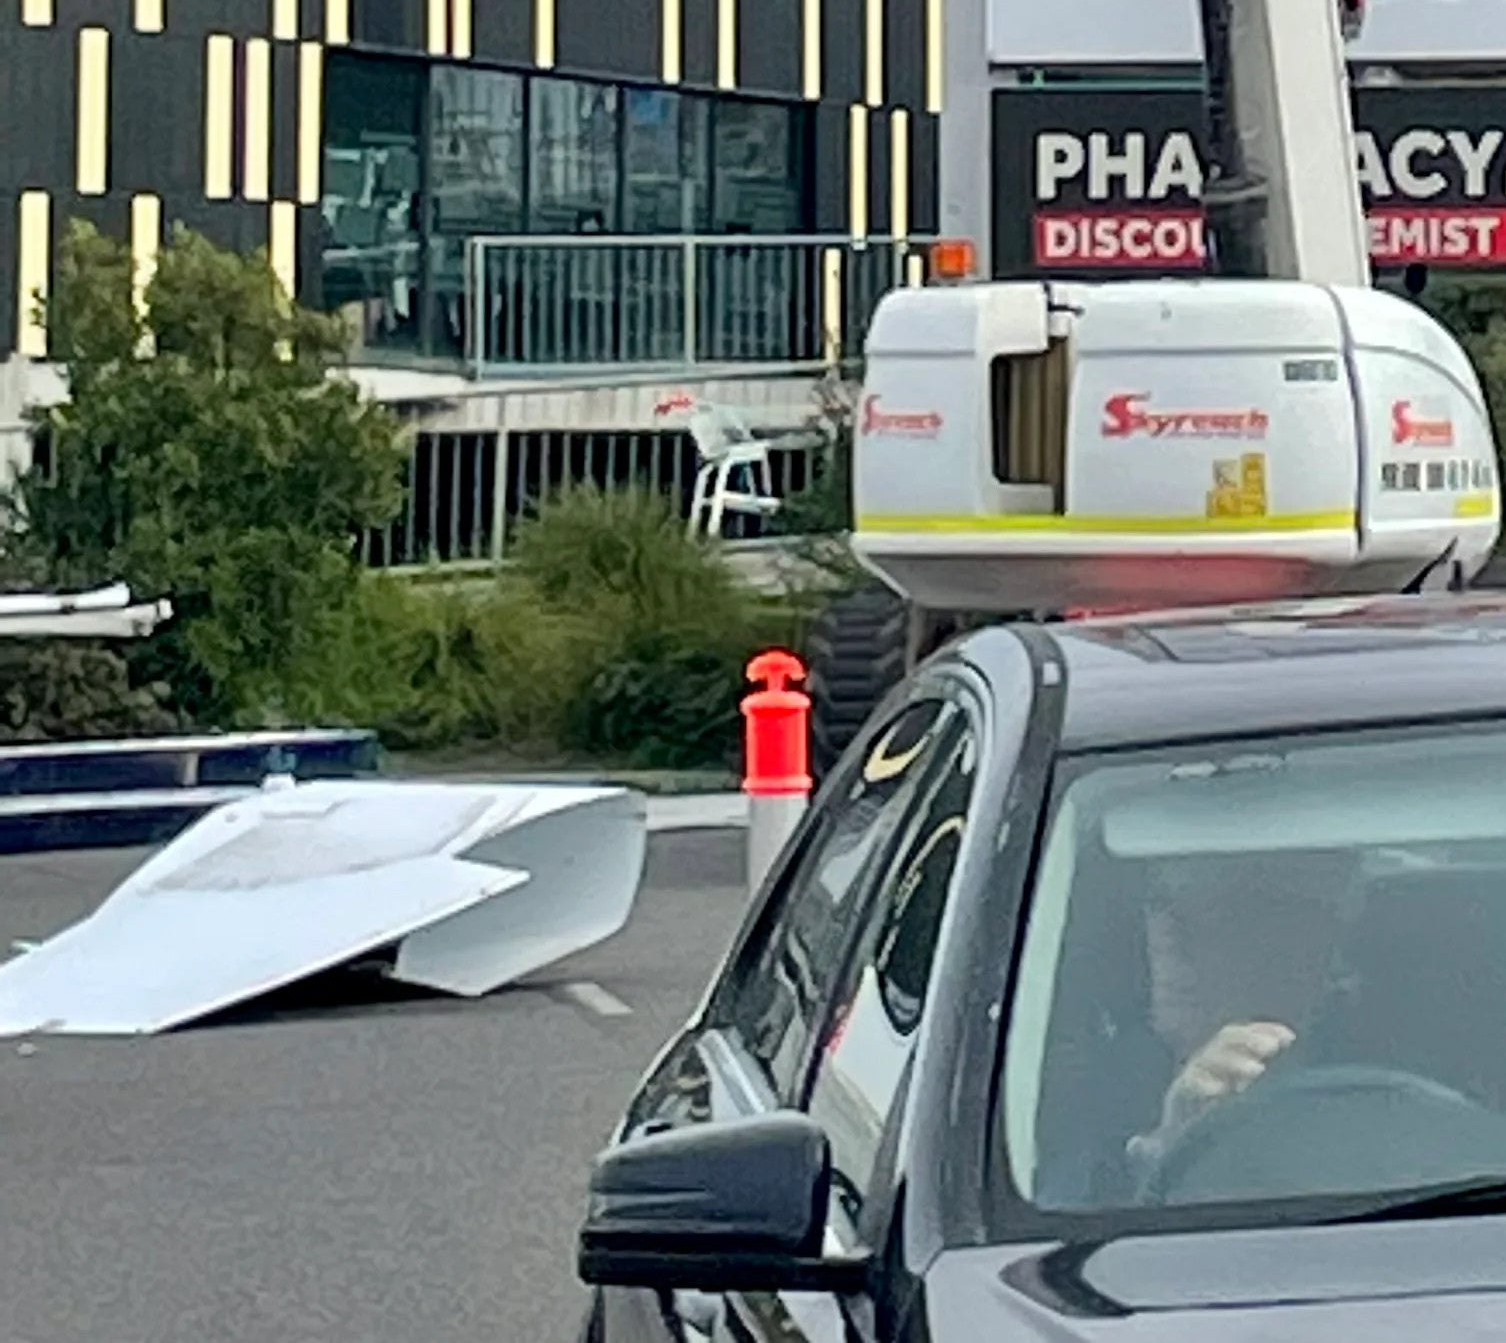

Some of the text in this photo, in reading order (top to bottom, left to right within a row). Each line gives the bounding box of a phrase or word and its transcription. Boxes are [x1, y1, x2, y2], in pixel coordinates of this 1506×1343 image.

[1036, 129, 1503, 199] PHAACY
[1045, 216, 1500, 258] DISCO EMIST
